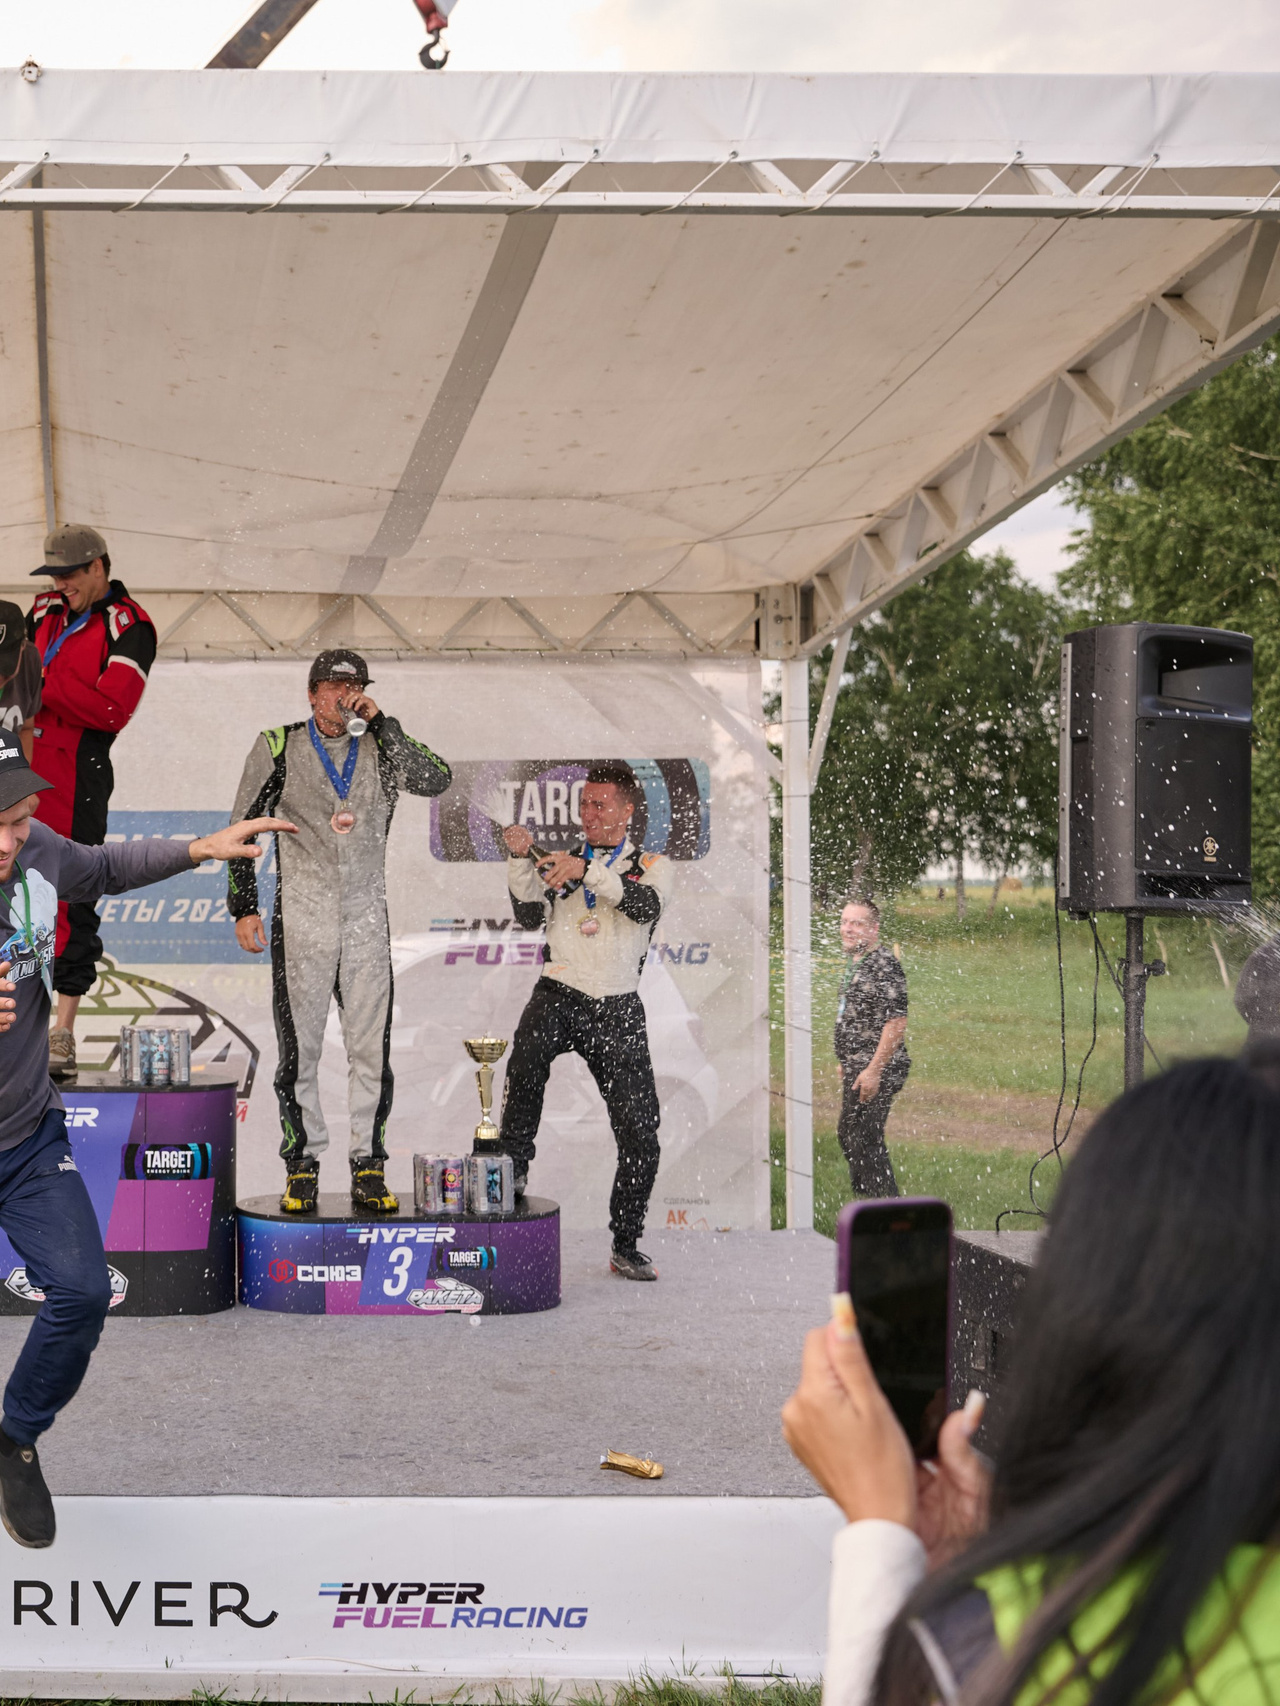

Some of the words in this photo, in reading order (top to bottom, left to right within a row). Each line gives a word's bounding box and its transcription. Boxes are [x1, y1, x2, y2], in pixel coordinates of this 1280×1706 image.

[145, 1150, 194, 1169] TARGET
[357, 1227, 456, 1244] HYPER
[448, 1251, 482, 1263] TARGET
[297, 1265, 362, 1282] СОЮЗ
[383, 1246, 413, 1297] 3
[409, 1290, 483, 1305] РАКЕТА
[336, 1582, 485, 1605] HYPER
[13, 1580, 279, 1629] RIVER
